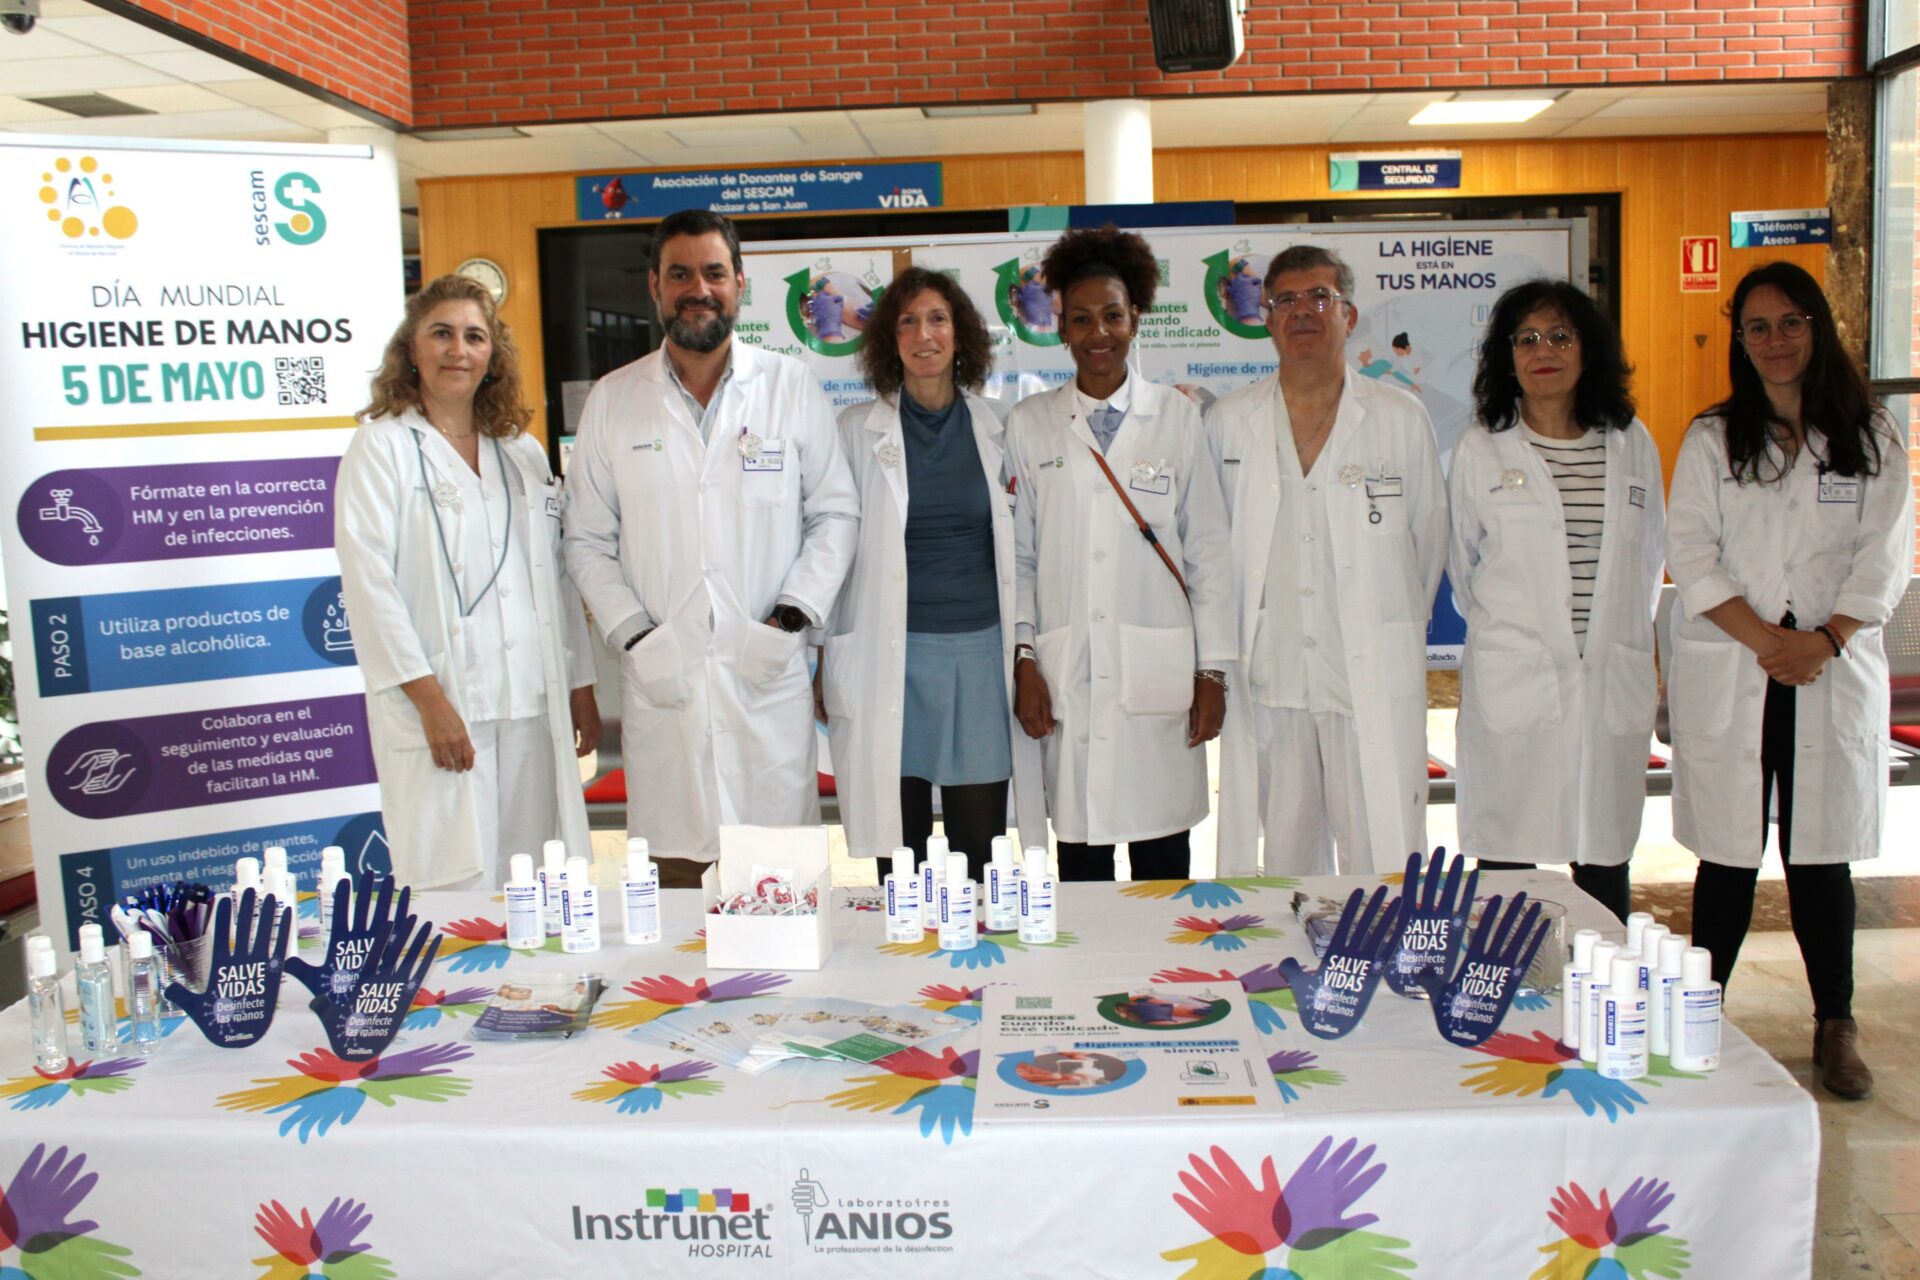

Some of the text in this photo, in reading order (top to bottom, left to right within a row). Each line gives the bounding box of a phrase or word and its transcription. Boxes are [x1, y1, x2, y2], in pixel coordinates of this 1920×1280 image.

[1381, 164, 1438, 175] CENTRAL DE
[653, 170, 863, 190] Asociación de Donantes de Sangre
[1384, 174, 1435, 185] SEGURIDAD
[721, 184, 794, 200] del SESCAM
[251, 170, 271, 247] sescam
[709, 198, 808, 212] Alcázar de San Juan
[1752, 222, 1806, 233] Teléfonos
[1379, 241, 1406, 257] LA
[1762, 235, 1797, 246] Aseos
[1441, 261, 1455, 270] EN
[1376, 272, 1497, 291] TUS MANOS
[92, 279, 285, 308] DÍA MUNDIAL
[1151, 303, 1189, 314] antes
[1140, 314, 1181, 326] uando
[22, 318, 353, 349] HIGIENE DE MANOS
[1140, 326, 1221, 338] sté indicado
[1187, 362, 1238, 378] Higiene
[1242, 362, 1257, 374] de
[62, 360, 266, 406] 5 DE MAYO
[823, 380, 840, 391] de
[130, 476, 327, 501] Fórmate en la correcta
[132, 499, 325, 527] HM y en la prevención
[164, 524, 296, 547] de infecciones.
[99, 604, 290, 637] Utiliza productos de
[48, 613, 73, 680] PASO 2
[120, 631, 272, 662] base alcohólica.
[1426, 653, 1457, 661] ollado
[201, 706, 312, 732] Colabora en el
[160, 721, 355, 758] seguimiento y evaluación
[187, 745, 333, 777] de las medidas que
[206, 768, 320, 795] facilitan la HM.
[127, 857, 148, 871] Un
[150, 854, 176, 868] uso
[178, 842, 240, 863] indebido
[241, 839, 259, 854] de
[77, 866, 94, 878] 4
[120, 872, 184, 890] aumenta
[185, 867, 200, 881] el
[202, 862, 238, 880] riesg
[336, 937, 375, 956] SALV
[1403, 934, 1448, 950] VIDAS
[335, 953, 368, 971] VID
[1399, 950, 1446, 963] Desinfecte
[218, 962, 266, 982] SALVE
[1327, 955, 1371, 976] SALVE
[1398, 963, 1412, 974] las
[1465, 962, 1511, 983] SALVE
[334, 971, 360, 983] Desin
[1323, 970, 1366, 992] VIDAS
[217, 978, 266, 998] VIDAS
[358, 983, 404, 998] SALVE
[1462, 978, 1505, 999] VIDAS
[216, 996, 265, 1012] Desinfecte
[355, 998, 399, 1013] VIDAS
[1318, 989, 1359, 1006] Desinfecte
[1454, 995, 1498, 1012] Desinfecte
[216, 1010, 265, 1024] las manos
[1313, 1000, 1355, 1017] las manos
[1450, 1008, 1494, 1024] las manos
[349, 1013, 393, 1026] Desinfecte
[345, 1027, 390, 1038] las manos
[1075, 1041, 1145, 1049] Higiene
[814, 1211, 954, 1241] ANIOS
[688, 1244, 773, 1259] HOSPITAL
[814, 1244, 954, 1255] Le professionnel de la désinfection
